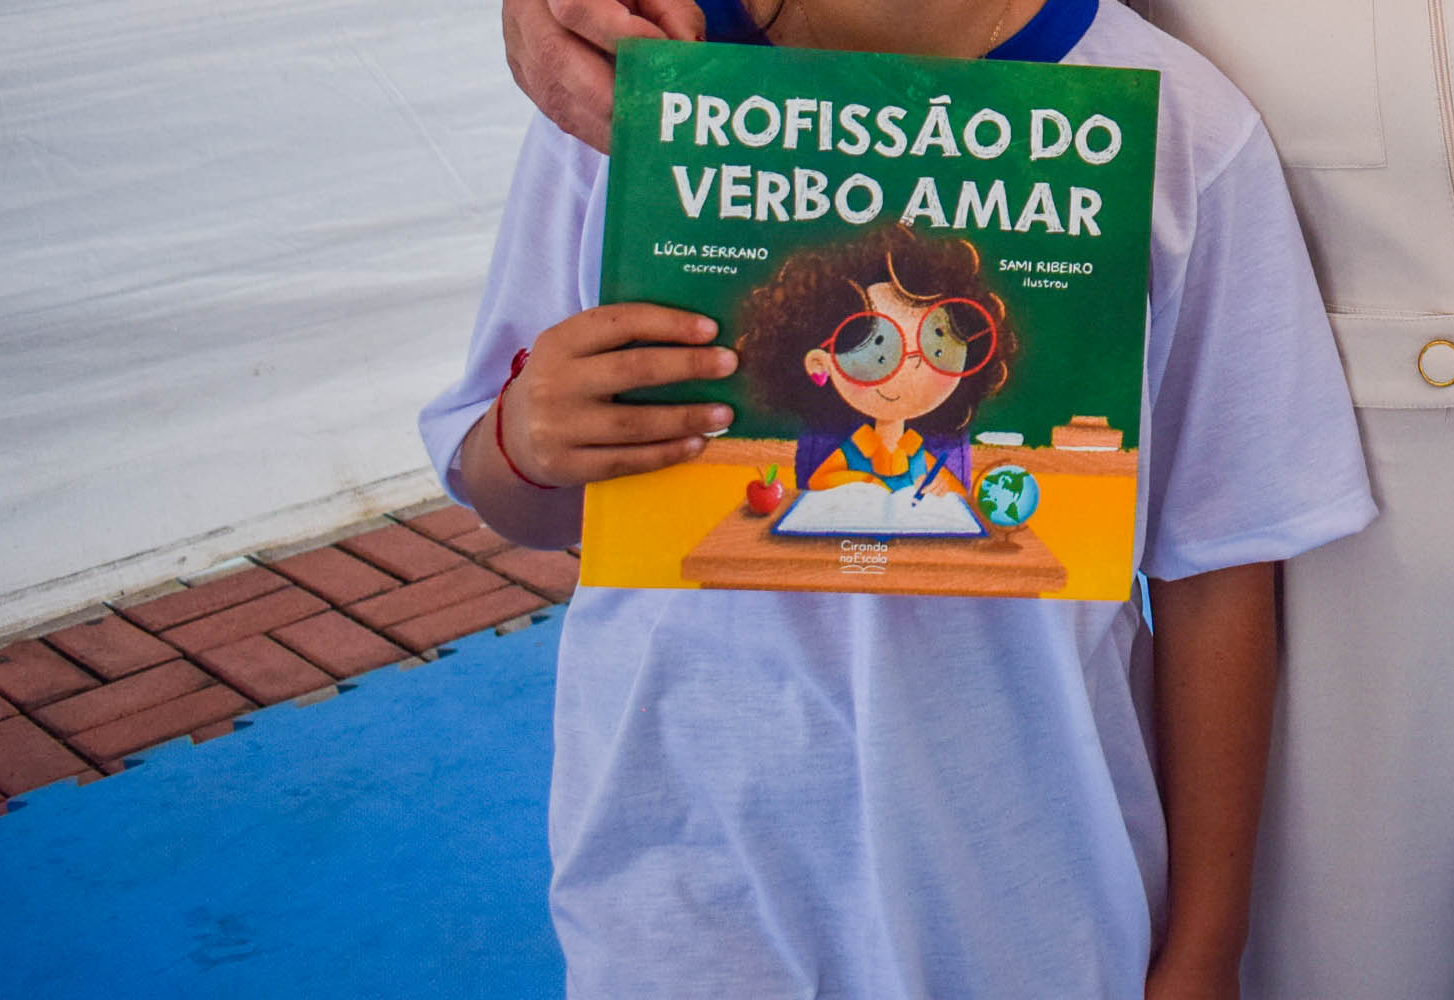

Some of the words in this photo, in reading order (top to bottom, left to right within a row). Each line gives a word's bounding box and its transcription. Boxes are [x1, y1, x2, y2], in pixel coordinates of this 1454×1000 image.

[659, 91, 1012, 160] PROFISSÃO
[1029, 108, 1123, 166] DO
[671, 164, 884, 226] VERBO
[900, 176, 1103, 237] AMAR
[653, 240, 697, 256] LÚCIA
[701, 245, 769, 260] SERRANO
[683, 263, 738, 275] escreveu
[998, 259, 1032, 272] SAMI
[1036, 261, 1094, 275] RIBEIRO
[1022, 277, 1068, 289] ilustrou
[841, 540, 888, 552] Ciranda
[854, 552, 887, 564] Escola
